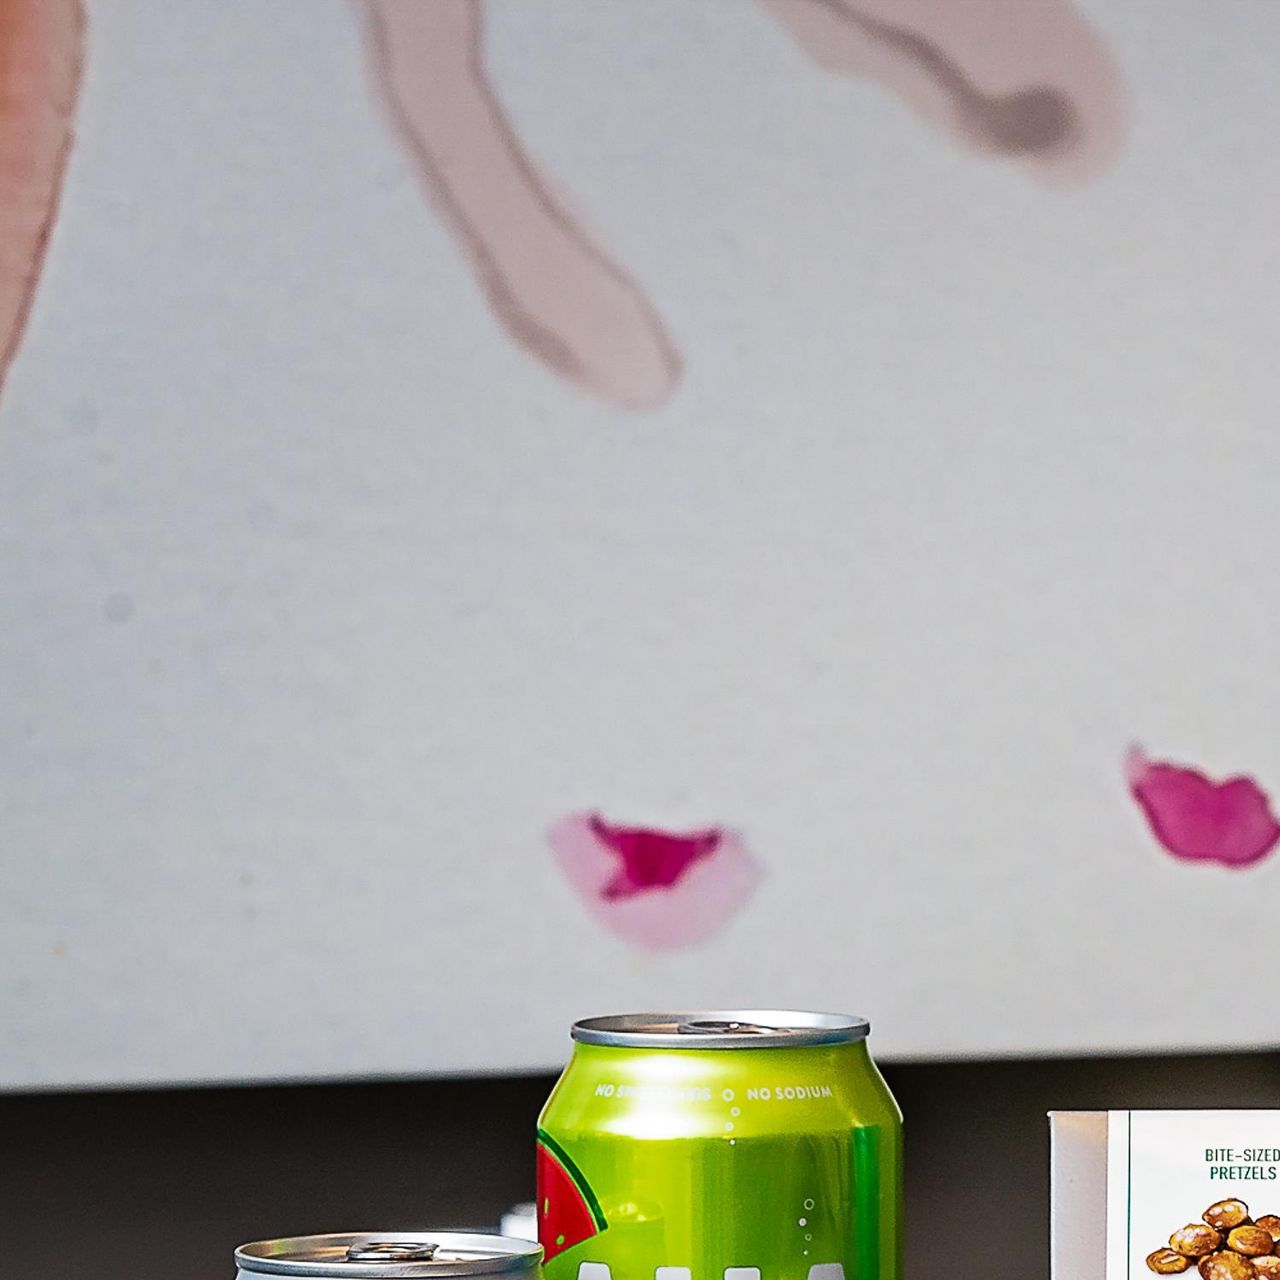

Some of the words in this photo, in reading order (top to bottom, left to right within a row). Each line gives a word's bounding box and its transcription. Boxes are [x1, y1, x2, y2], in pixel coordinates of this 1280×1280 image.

[747, 1087, 771, 1101] NO
[775, 1086, 832, 1100] SODIUM
[1205, 1148, 1280, 1162] BITE-SIZED
[1210, 1166, 1277, 1180] PRETZELS
